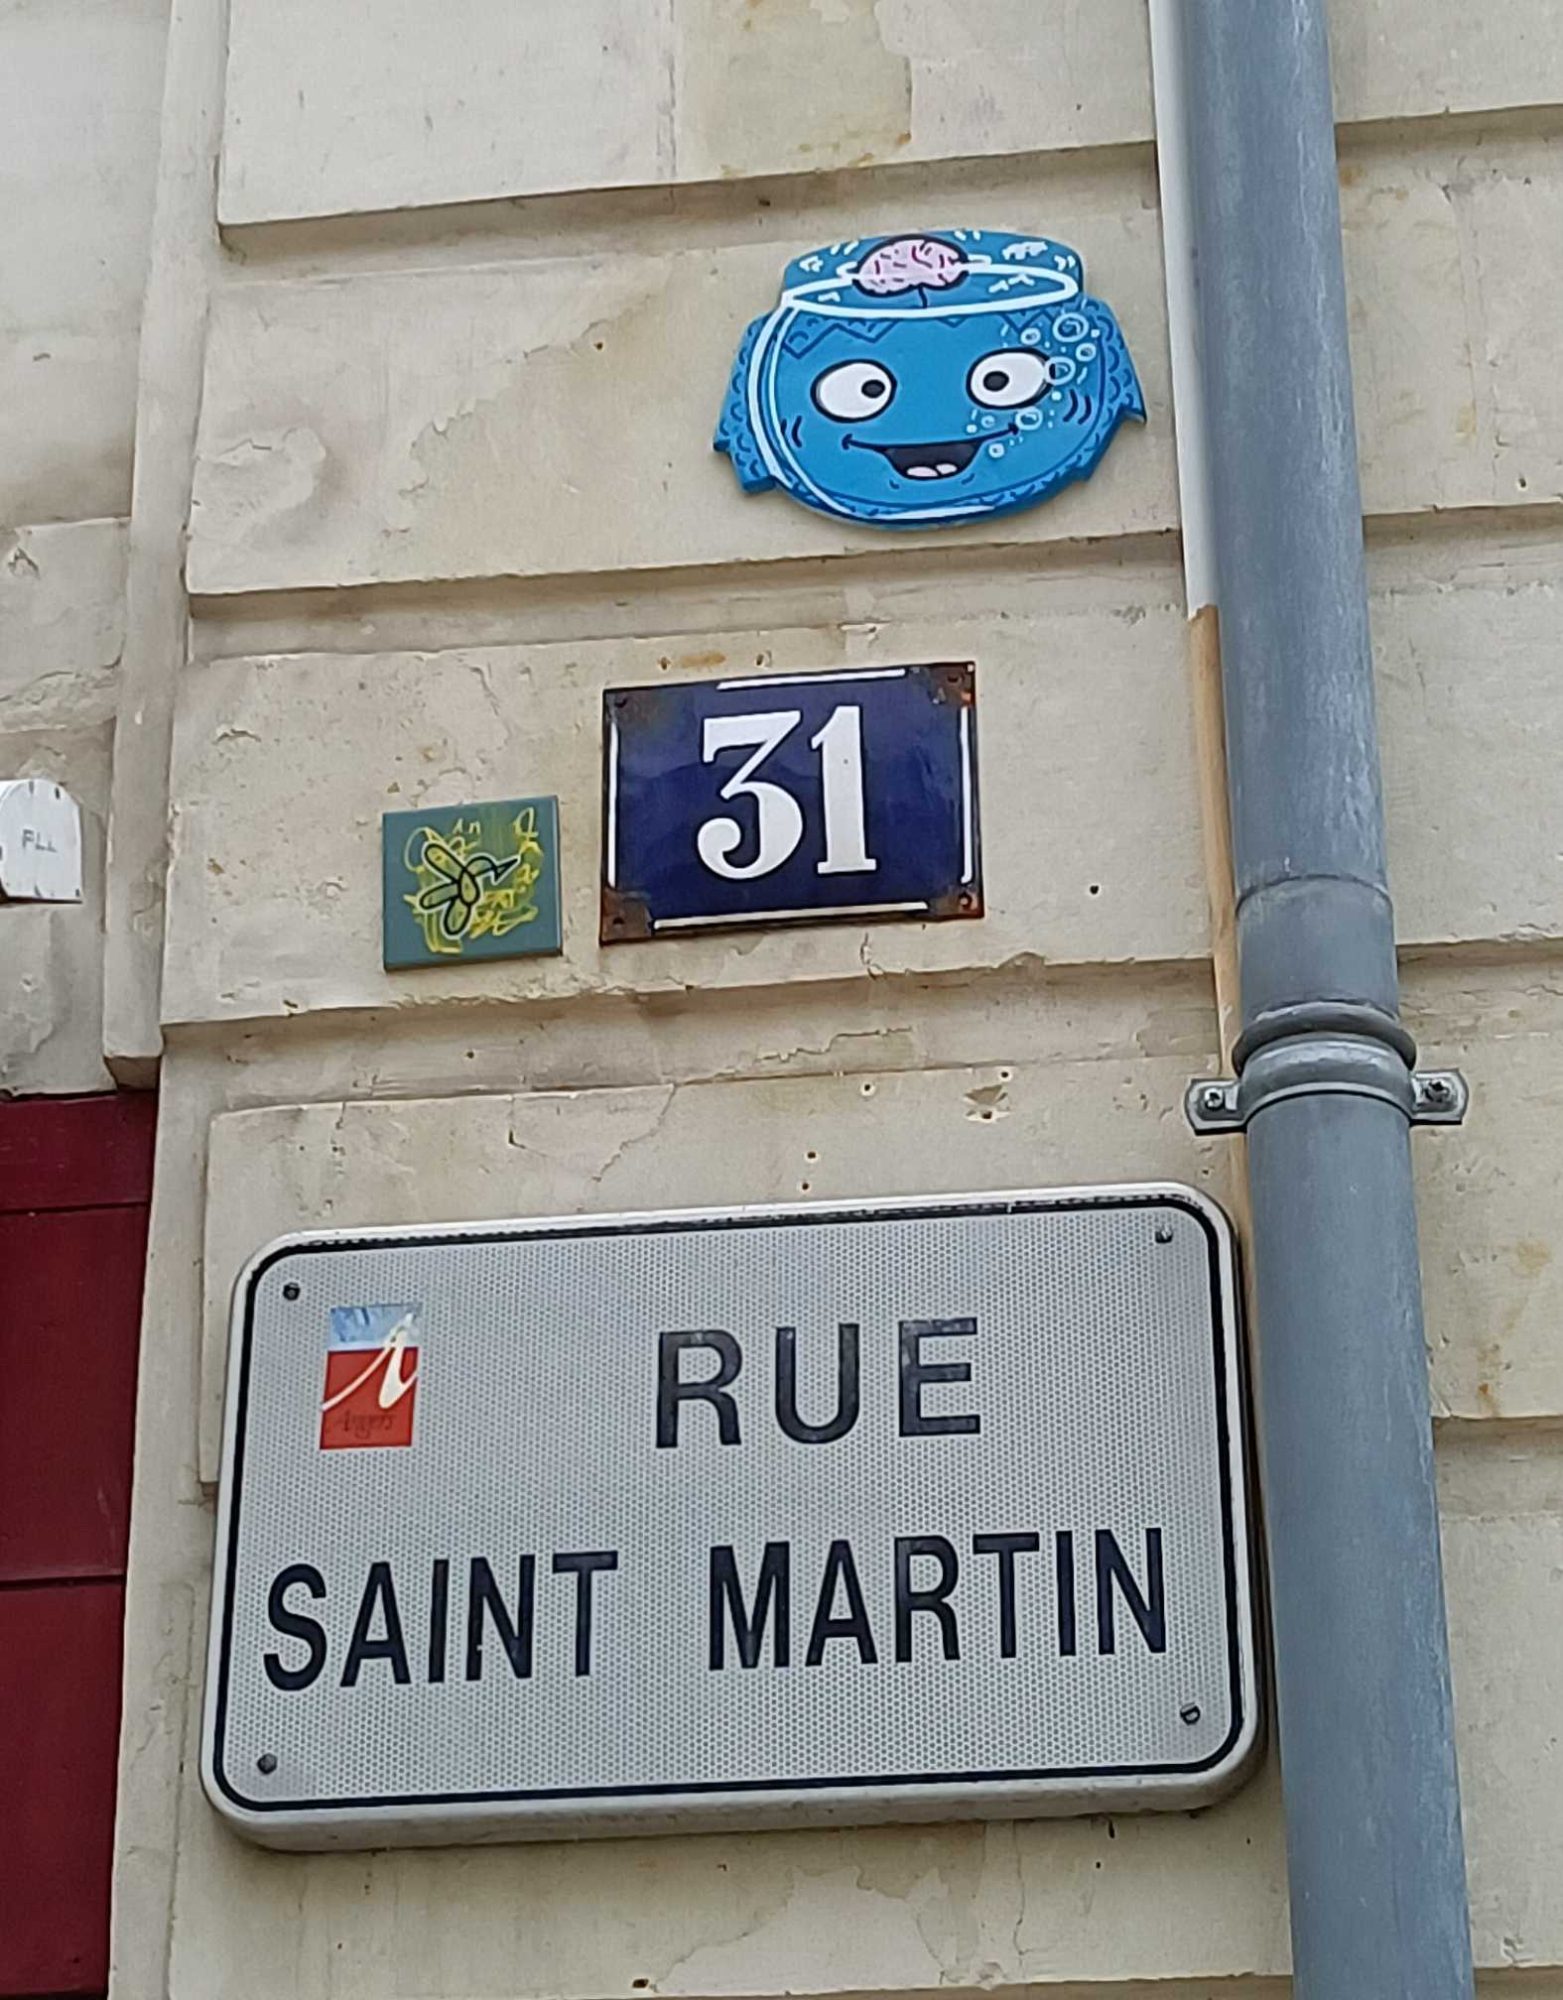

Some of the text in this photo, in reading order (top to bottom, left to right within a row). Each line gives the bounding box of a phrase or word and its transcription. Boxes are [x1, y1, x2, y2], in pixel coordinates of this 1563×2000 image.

[697, 705, 876, 879] 31
[656, 1316, 982, 1448] RUE
[263, 1528, 1168, 1690] SAINT MARTIN
